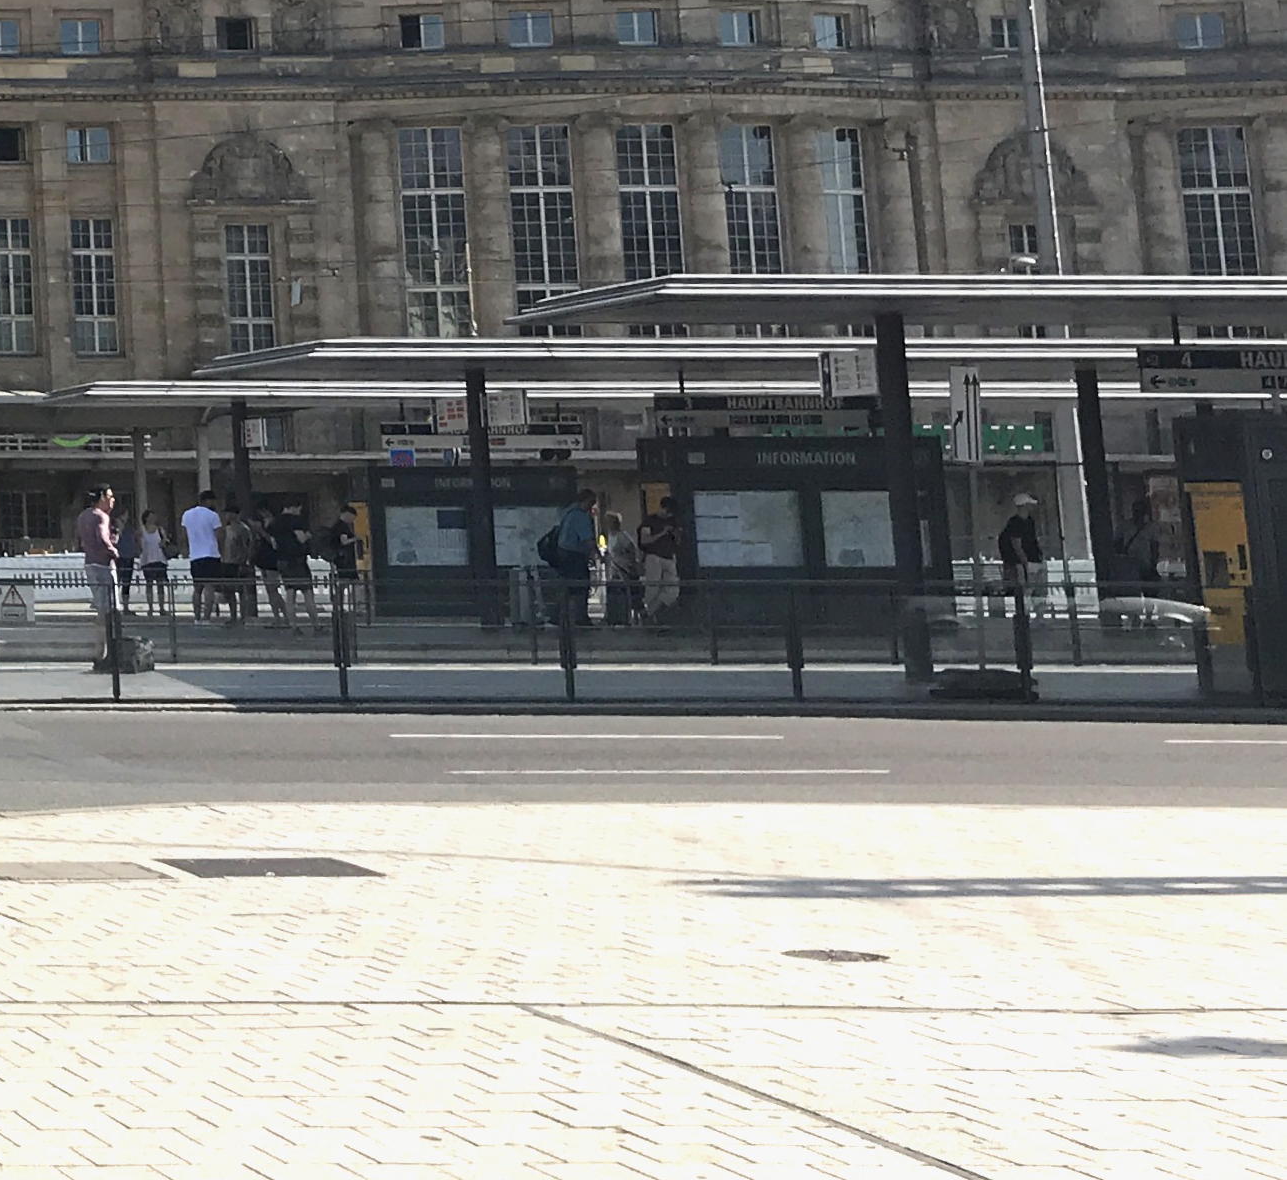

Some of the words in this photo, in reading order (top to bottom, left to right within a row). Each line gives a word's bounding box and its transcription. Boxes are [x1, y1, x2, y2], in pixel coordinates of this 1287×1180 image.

[1181, 352, 1192, 367] 4
[727, 397, 843, 410] HAUPTBAHNHOF
[756, 451, 856, 465] INFORMATION
